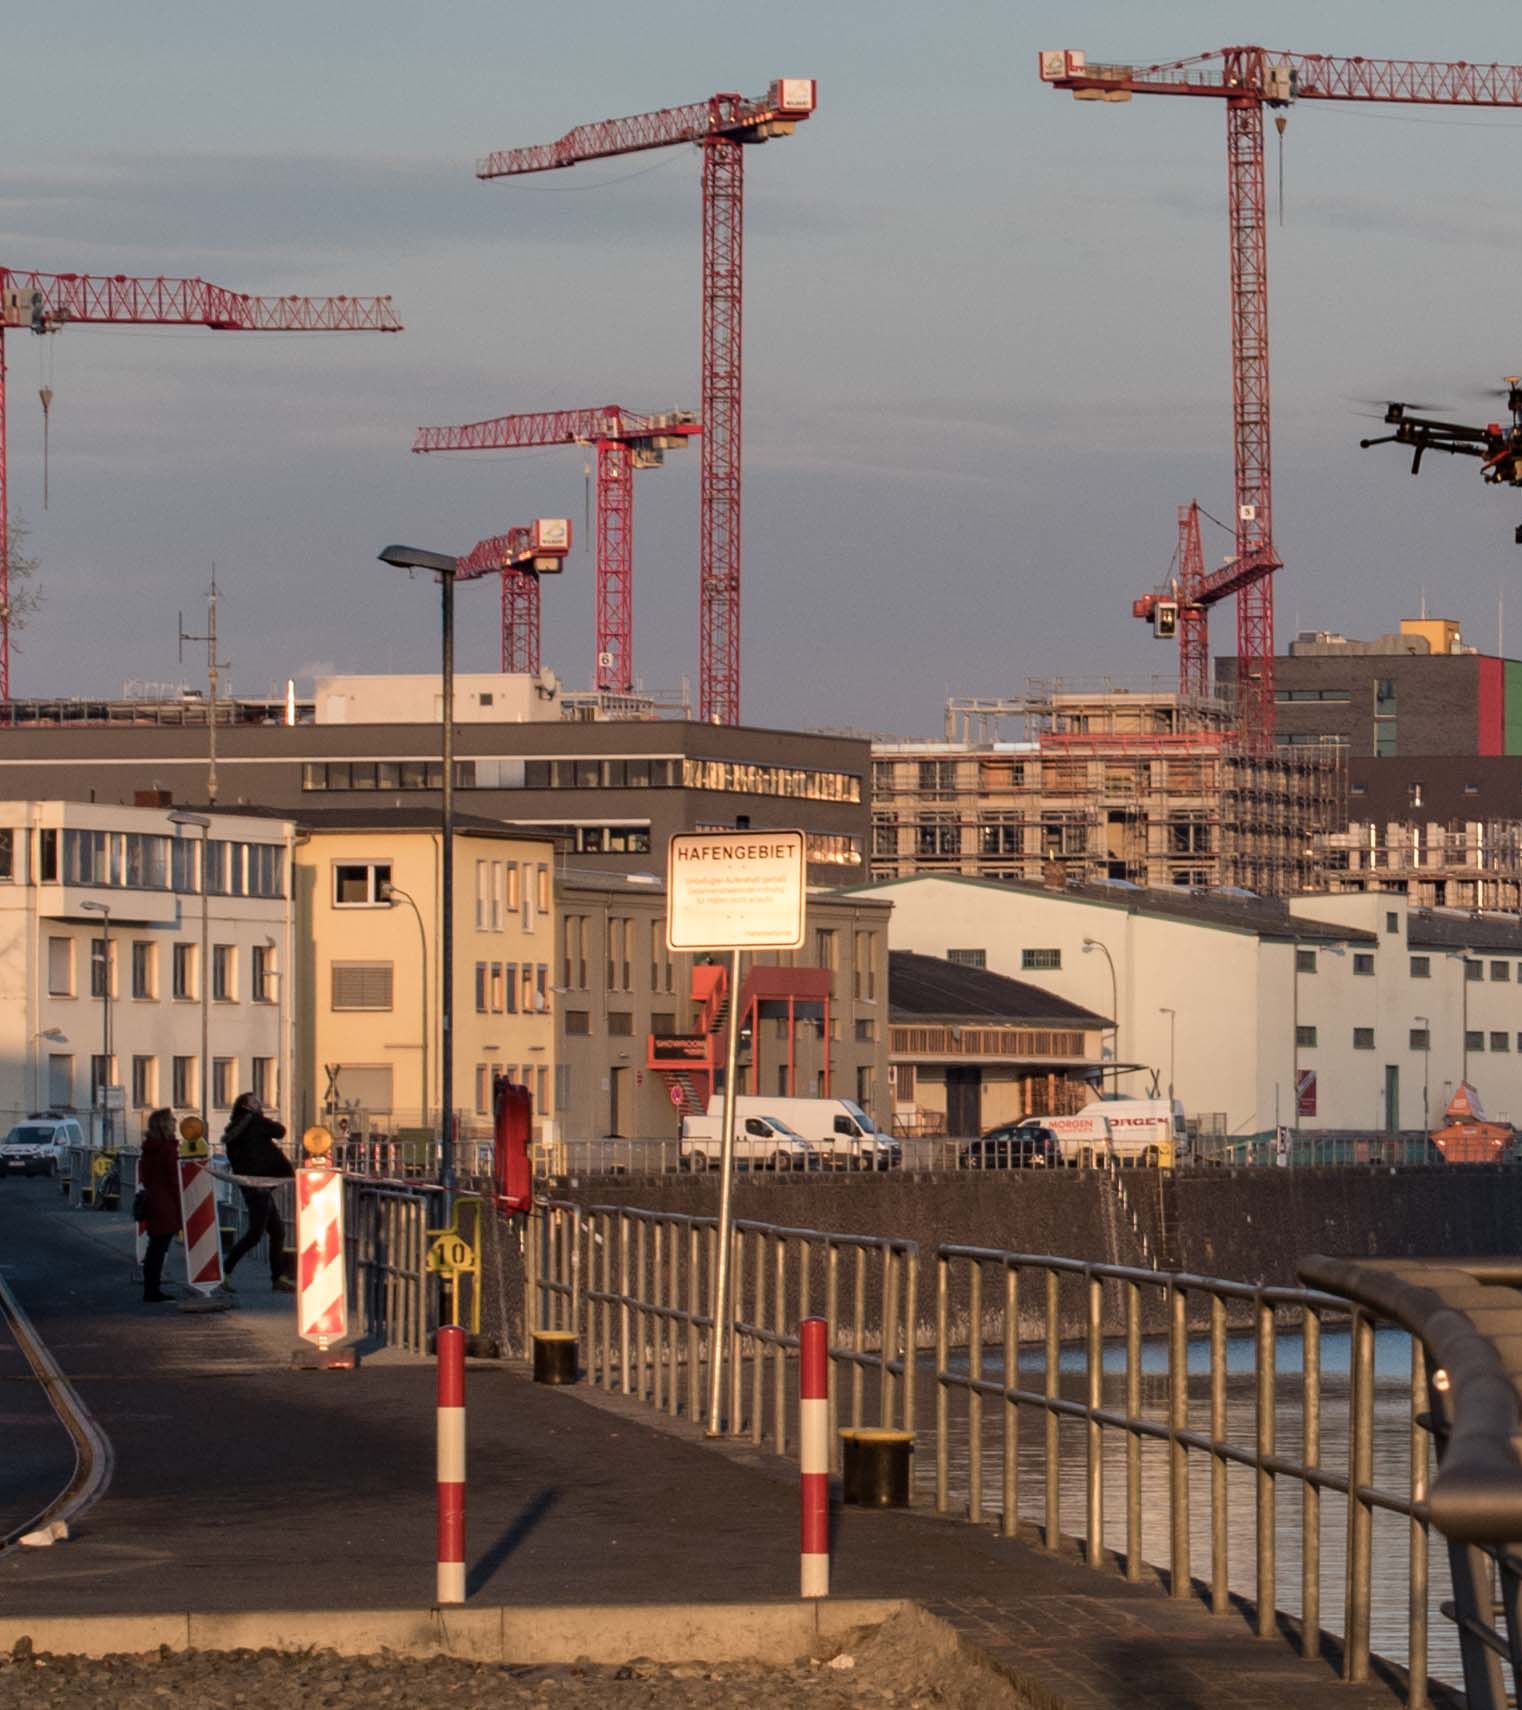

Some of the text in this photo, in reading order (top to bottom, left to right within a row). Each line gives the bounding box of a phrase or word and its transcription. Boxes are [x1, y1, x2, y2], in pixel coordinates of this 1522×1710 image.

[678, 845, 796, 860] HAFENGEBIET
[1050, 1119, 1093, 1129] MORGEN
[1109, 1117, 1169, 1127] ORGEN
[437, 1243, 465, 1264] 10
